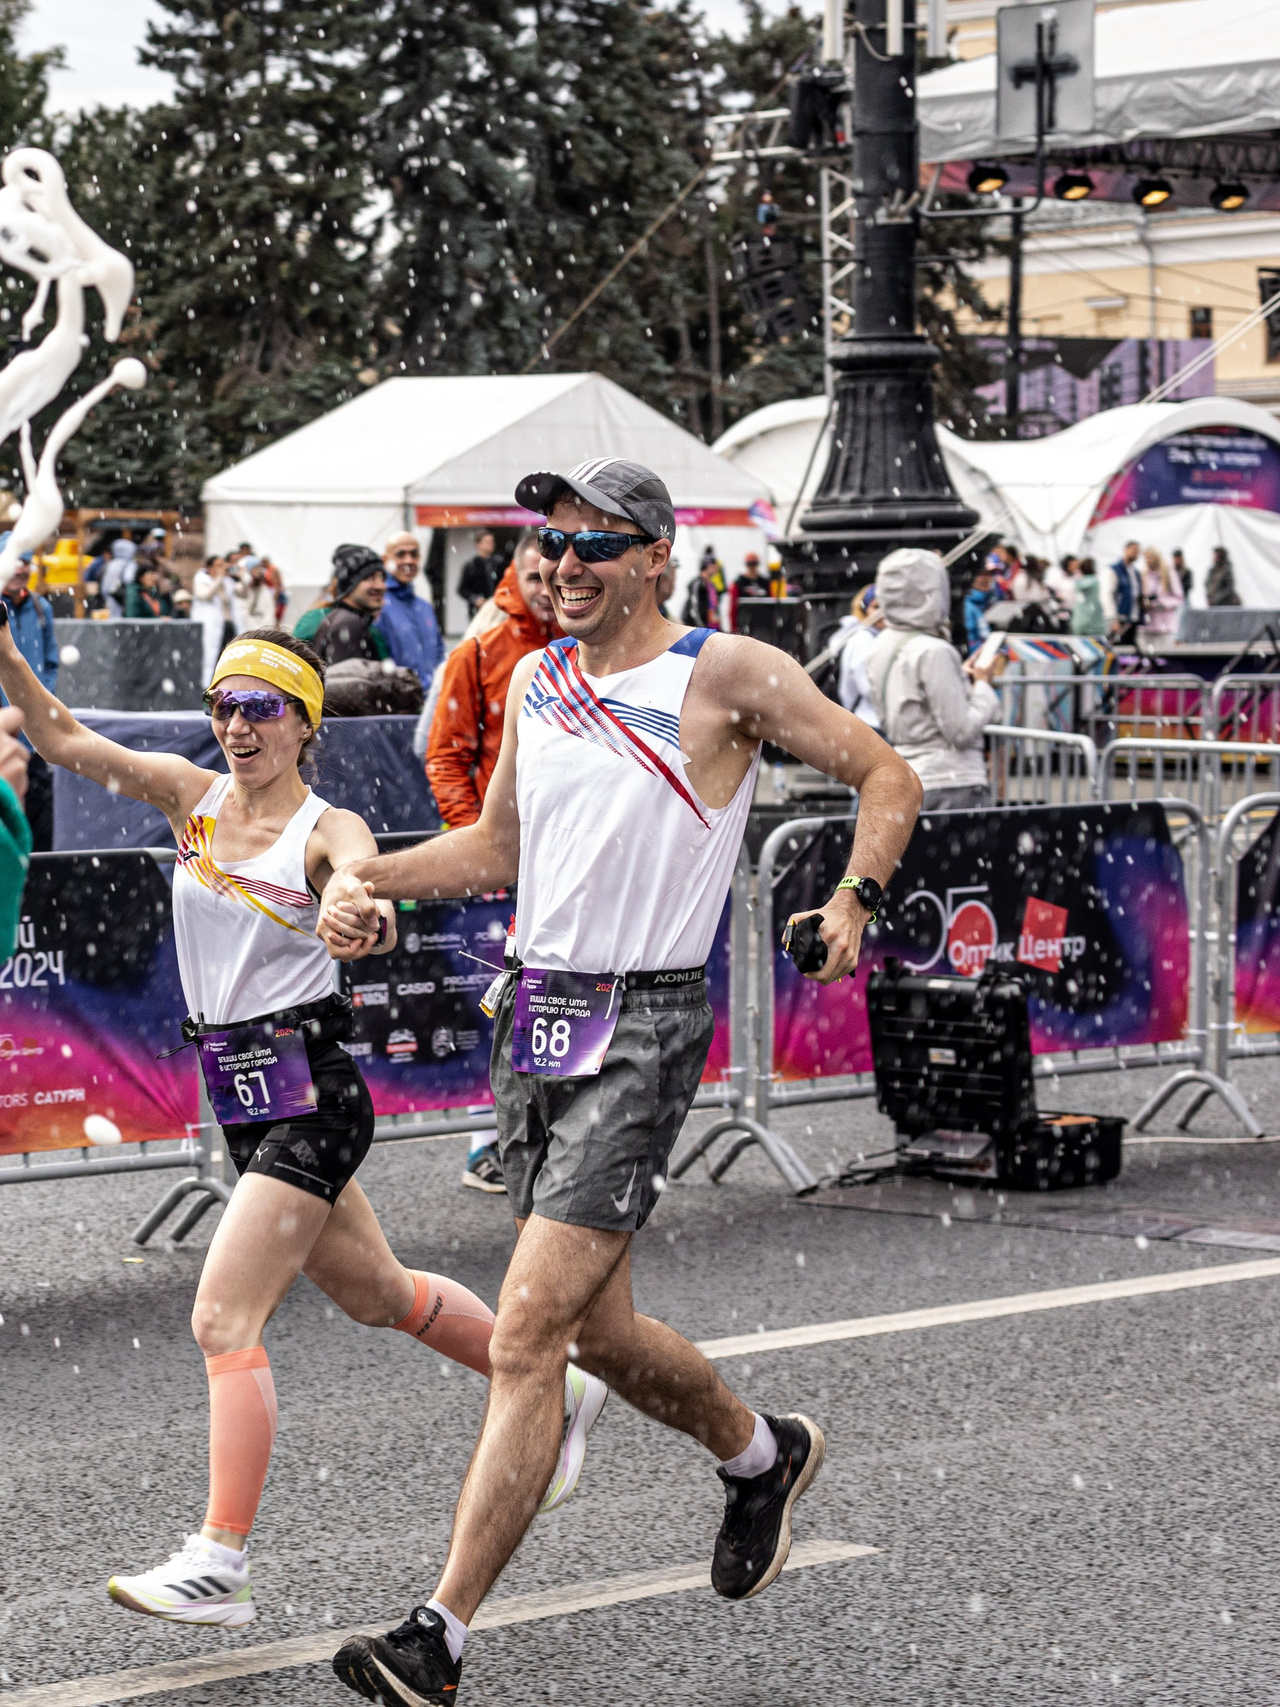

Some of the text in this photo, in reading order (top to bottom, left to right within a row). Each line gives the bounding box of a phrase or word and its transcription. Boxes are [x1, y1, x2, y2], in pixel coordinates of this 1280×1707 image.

[1019, 933, 1086, 962] Центр
[653, 969, 703, 984] AONIJIE
[396, 981, 436, 996] CASIO
[547, 996, 567, 1006] СВОЕ
[568, 998, 588, 1008] ИМЯ
[560, 1007, 591, 1018] ГОРОДА
[275, 1027, 295, 1038] 2024
[531, 1017, 571, 1058] 68
[237, 1051, 255, 1061] СВОЕ
[254, 1047, 272, 1058] ИМЯ
[250, 1056, 278, 1068] ГОРОДА
[33, 1087, 86, 1105] САТУРН
[233, 1070, 271, 1107] 67
